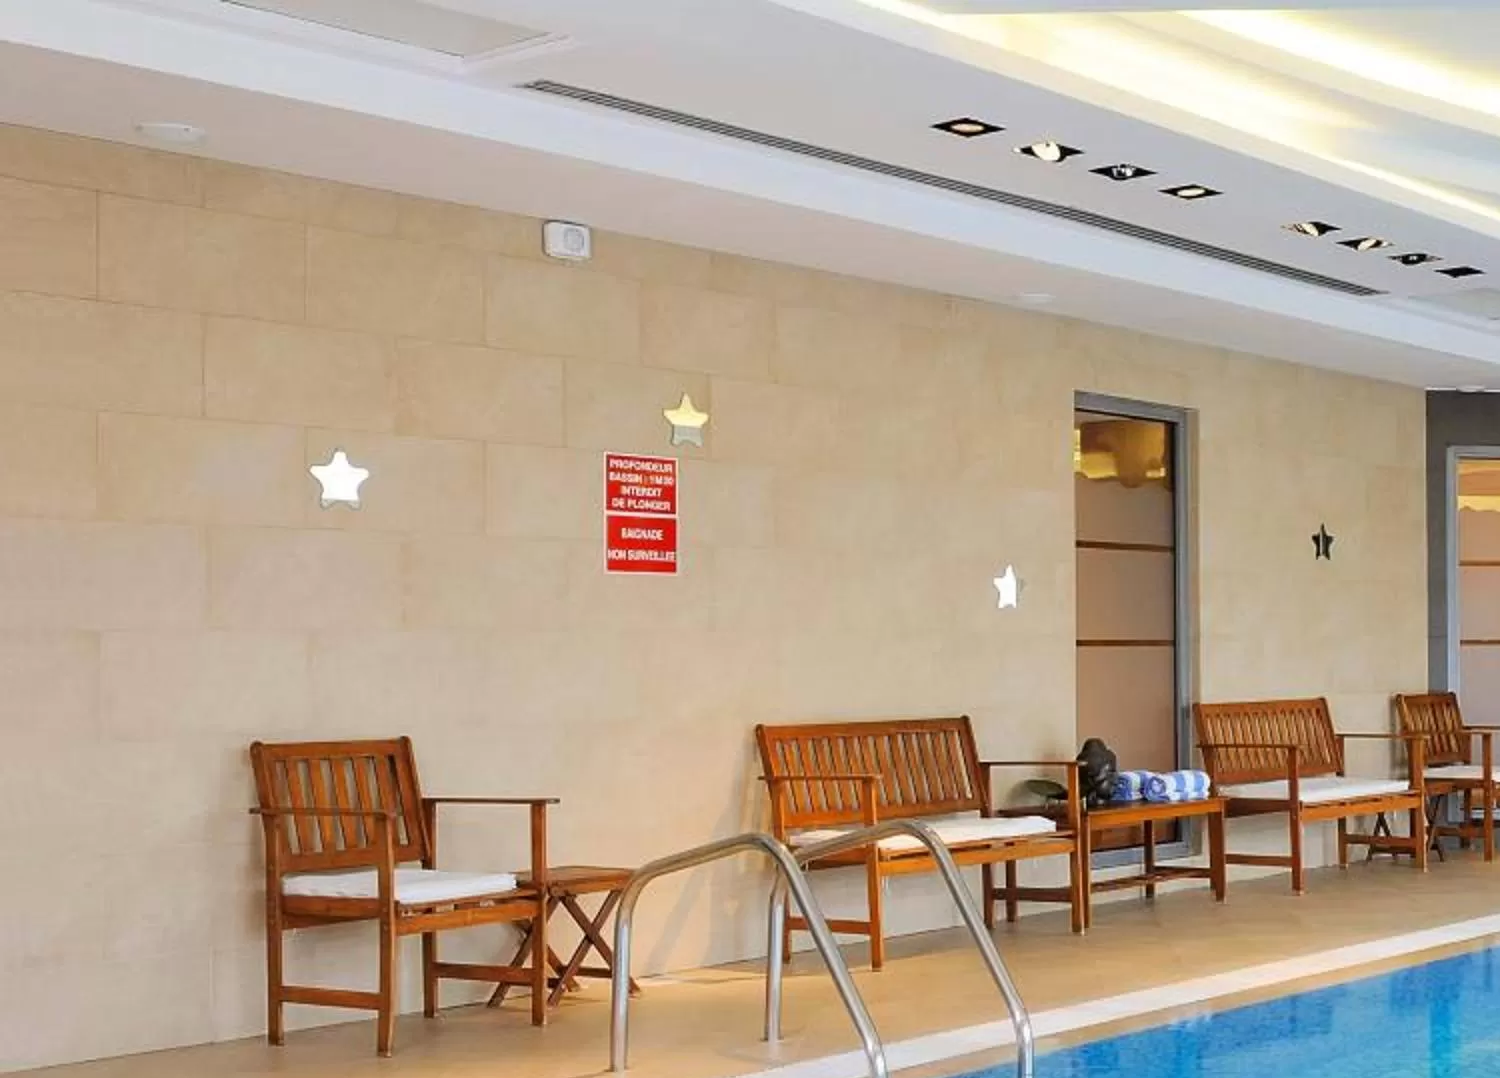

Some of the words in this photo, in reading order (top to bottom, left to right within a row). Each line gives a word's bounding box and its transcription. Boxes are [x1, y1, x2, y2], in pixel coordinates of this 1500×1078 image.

[609, 459, 673, 473] PROFONDEUR
[621, 486, 662, 497] INTERDIT
[611, 498, 625, 509] DE
[627, 498, 671, 511] PLONGER
[621, 528, 664, 541] BAIGNADE
[607, 549, 627, 560] NON
